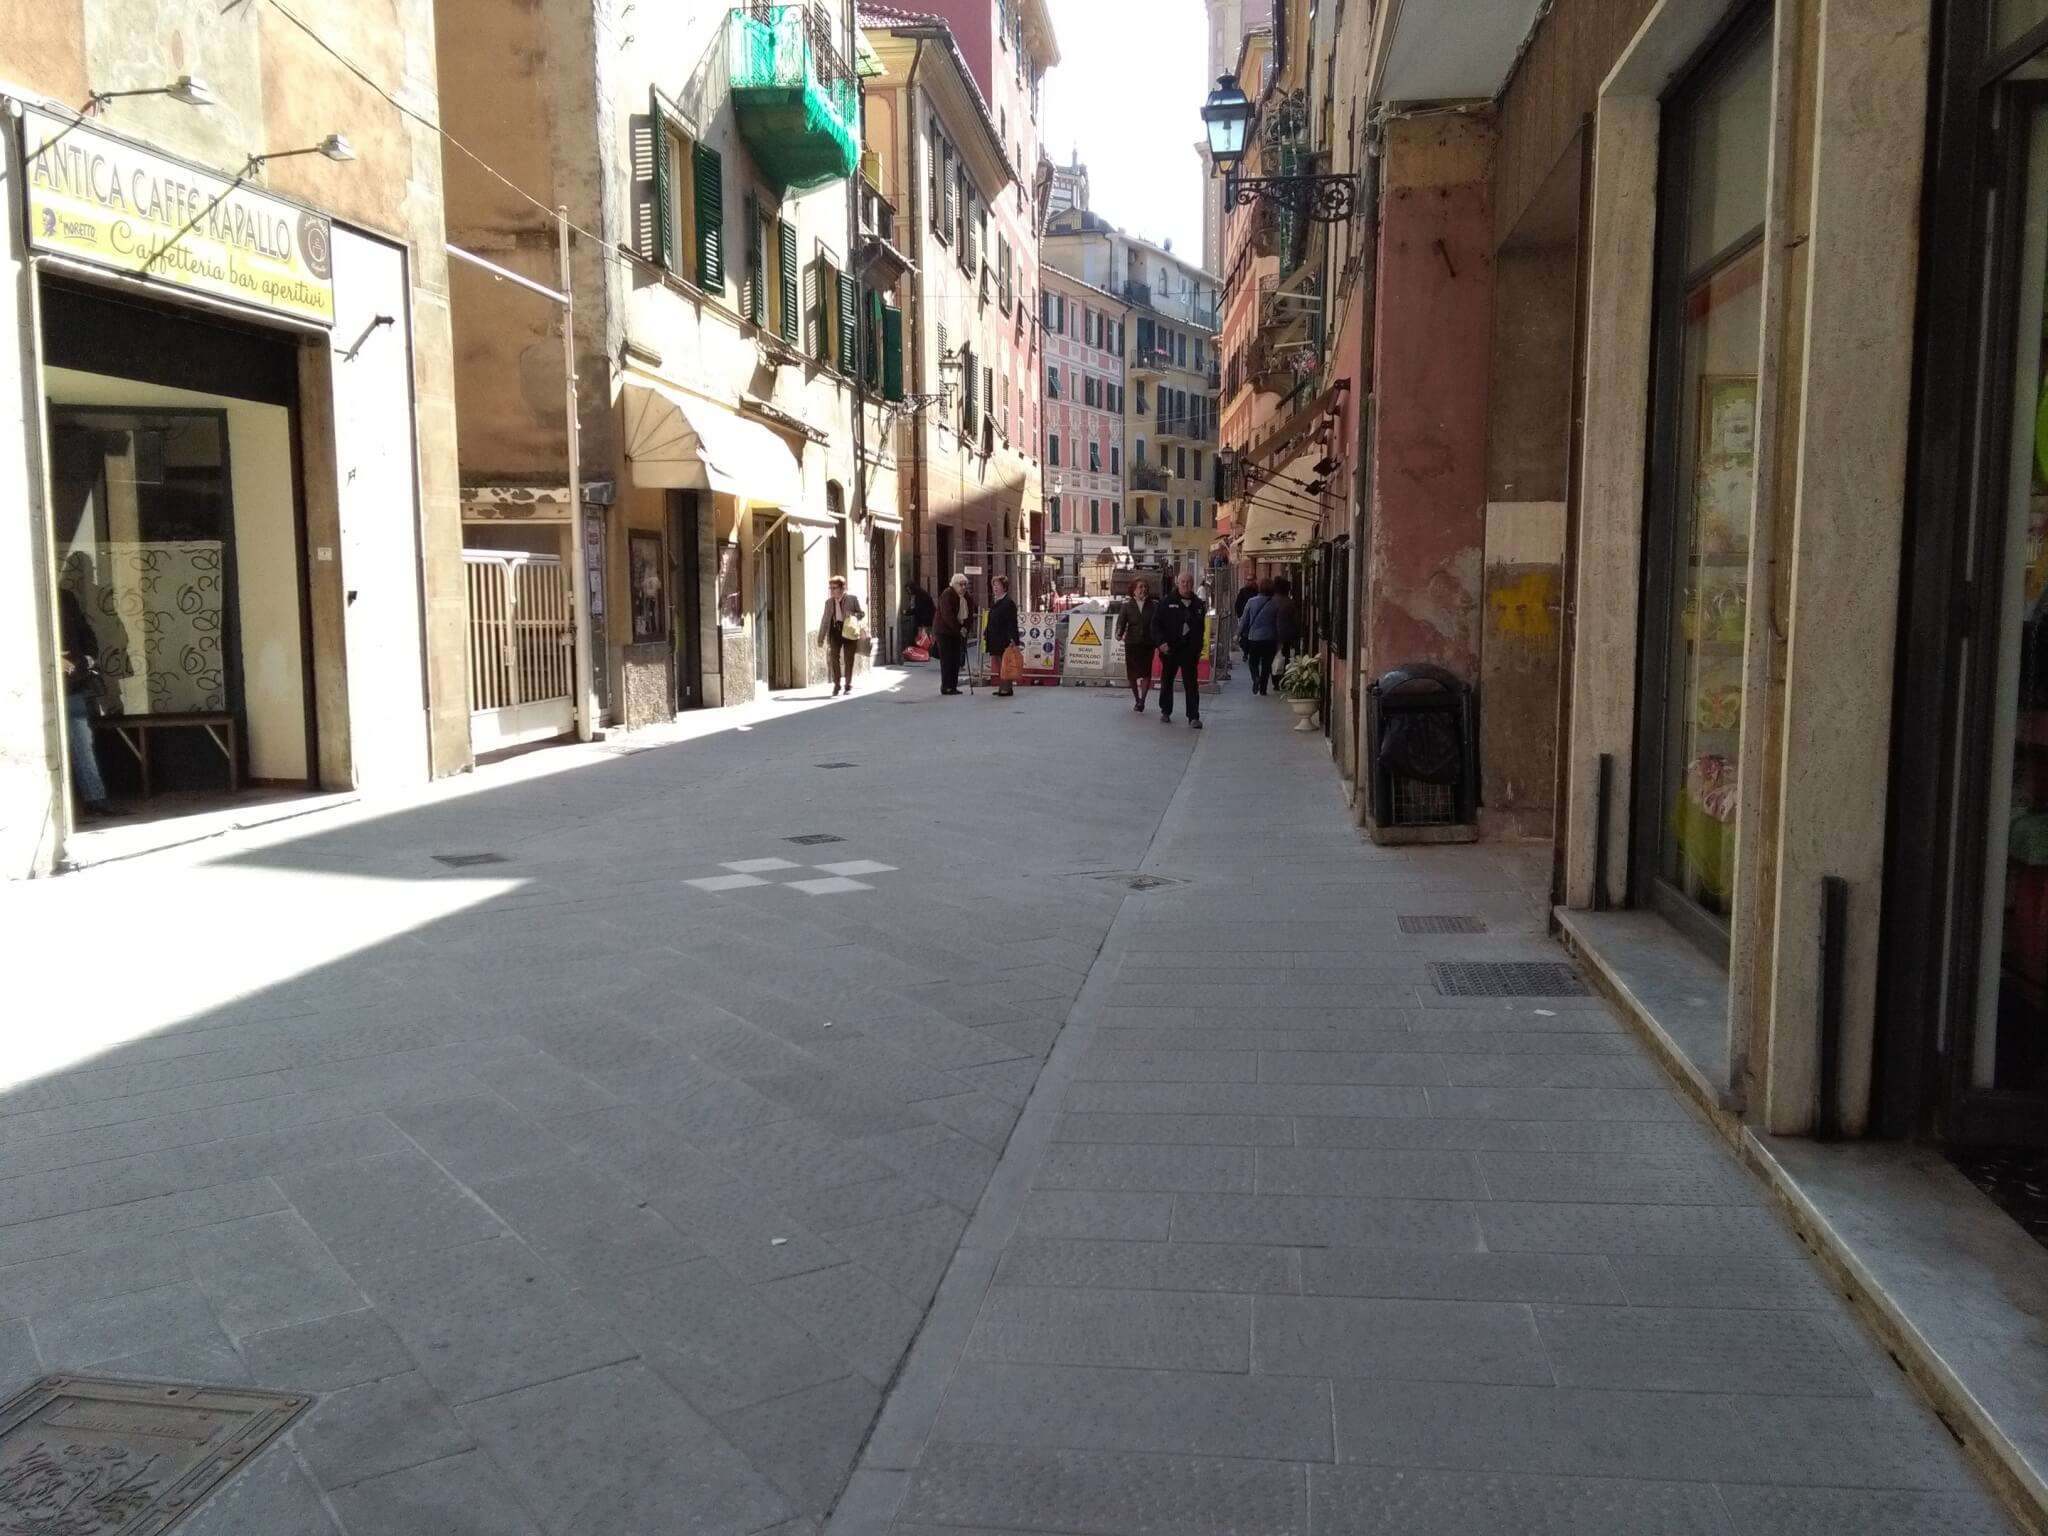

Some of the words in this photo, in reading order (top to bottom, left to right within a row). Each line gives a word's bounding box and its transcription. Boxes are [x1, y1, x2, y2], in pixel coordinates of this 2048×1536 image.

[33, 136, 127, 210] ANTICA
[208, 193, 291, 261] RAPALLO
[63, 222, 97, 239] MORETTO
[110, 219, 225, 280] Caffetteria
[229, 254, 257, 290] bar
[261, 279, 325, 308] aperitivi
